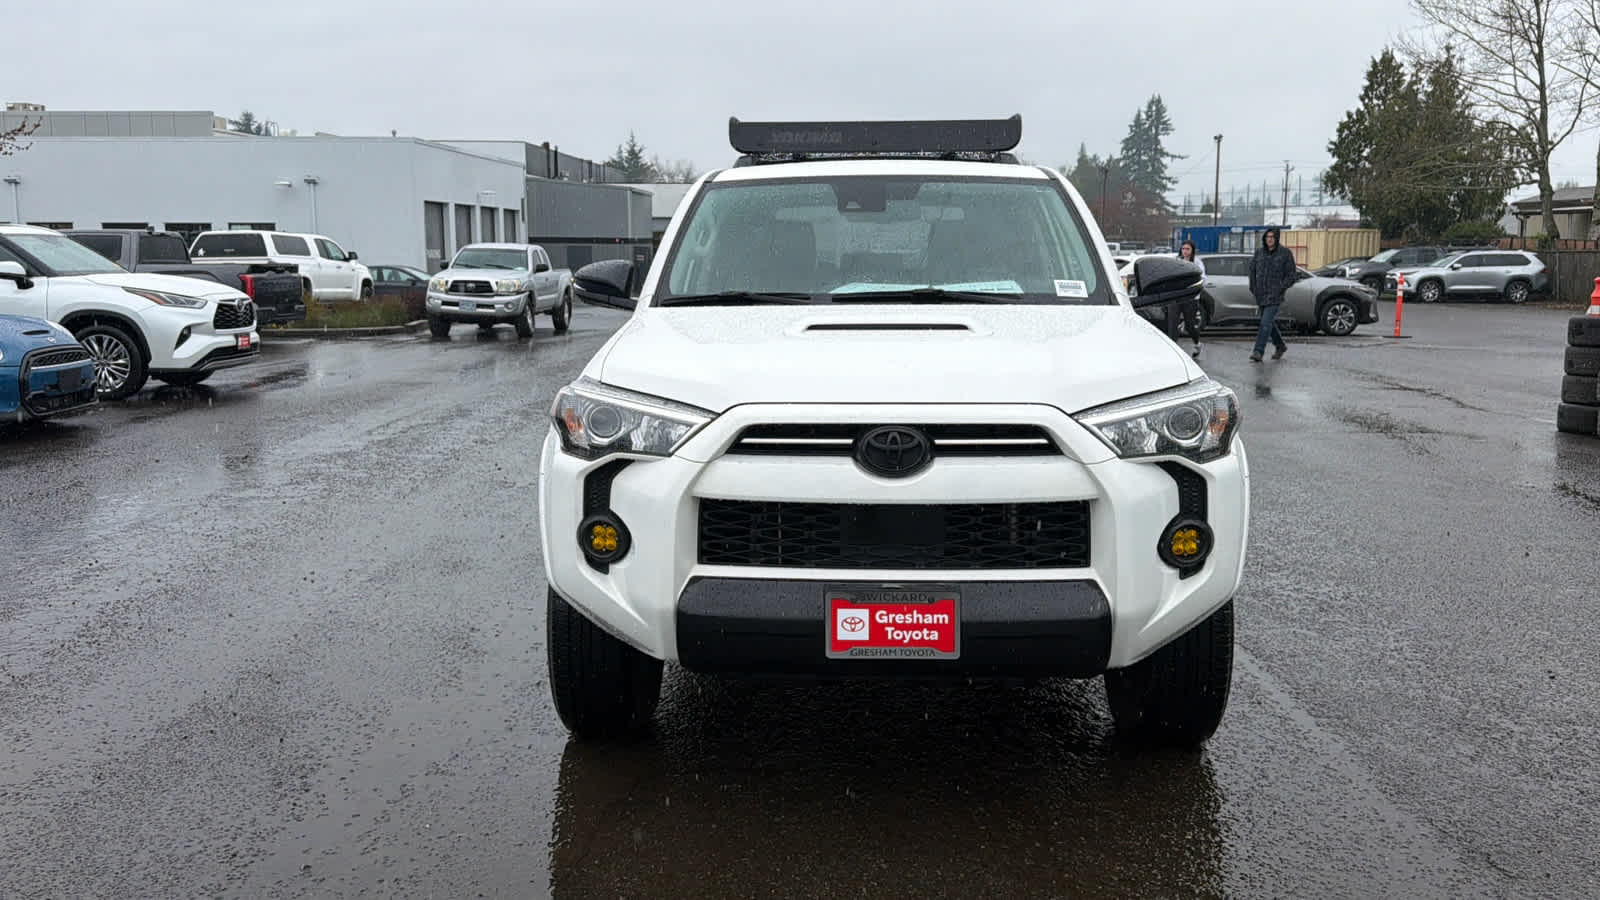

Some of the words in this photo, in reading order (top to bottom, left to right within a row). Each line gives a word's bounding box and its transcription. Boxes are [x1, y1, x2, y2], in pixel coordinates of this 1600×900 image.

[875, 610, 949, 624] Gresham
[885, 627, 939, 643] Toyota
[850, 648, 897, 657] GRESHAM
[899, 648, 936, 657] TOYOTA
